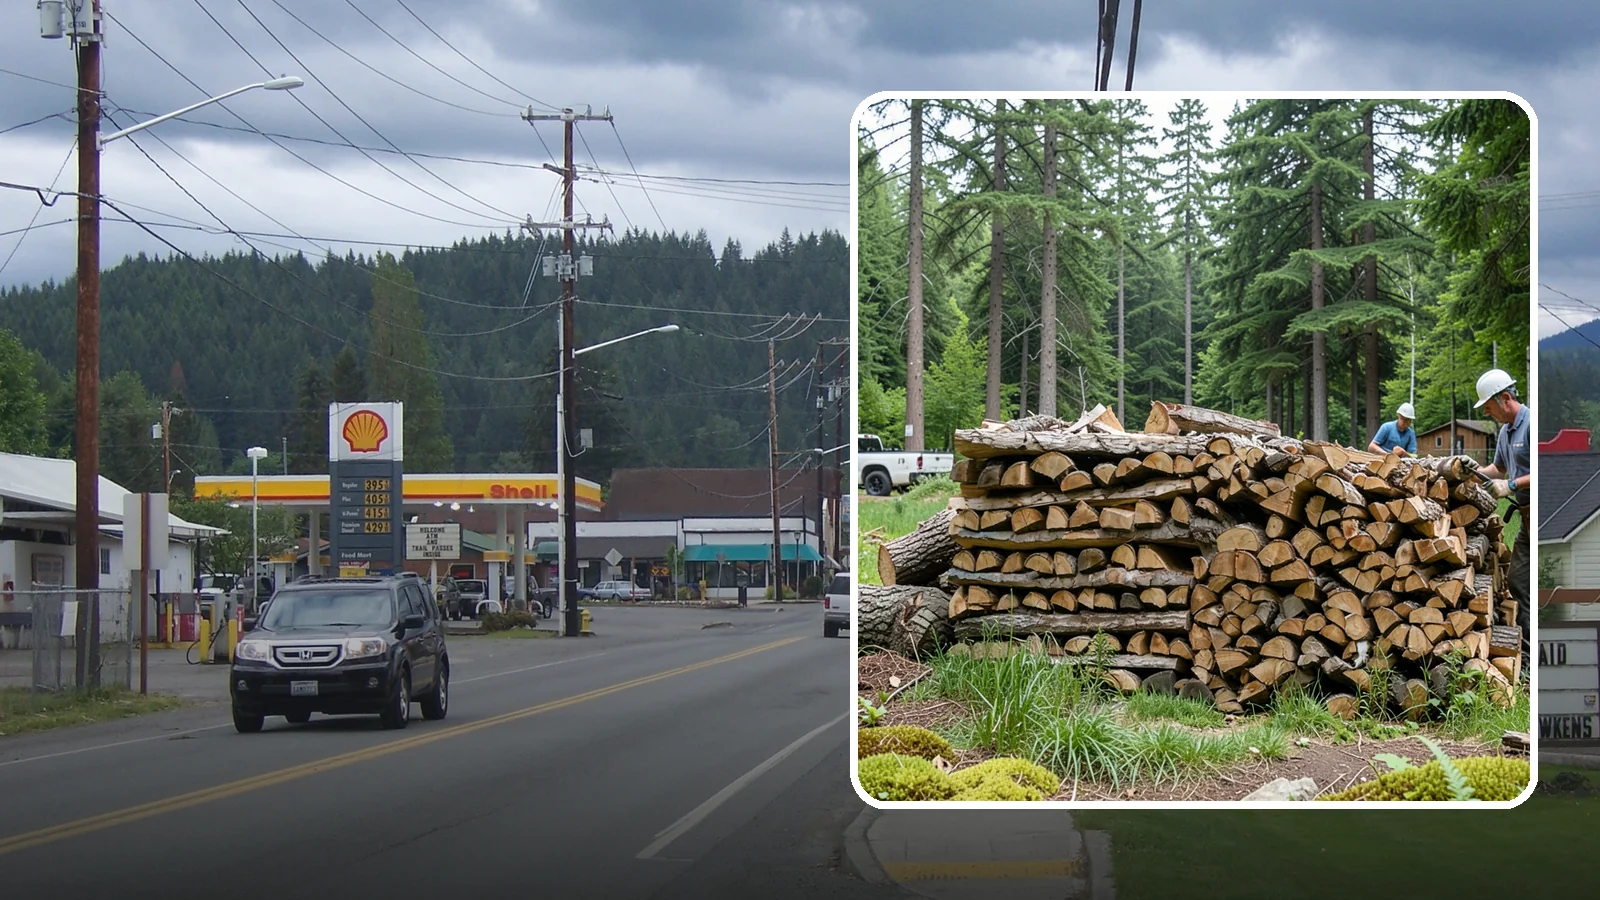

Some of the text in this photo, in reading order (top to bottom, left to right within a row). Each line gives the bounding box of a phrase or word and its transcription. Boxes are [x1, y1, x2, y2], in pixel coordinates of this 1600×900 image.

[366, 480, 383, 490] 395
[490, 484, 547, 499] Shell
[366, 494, 383, 504] 405
[366, 508, 383, 518] 415
[366, 522, 383, 532] 429
